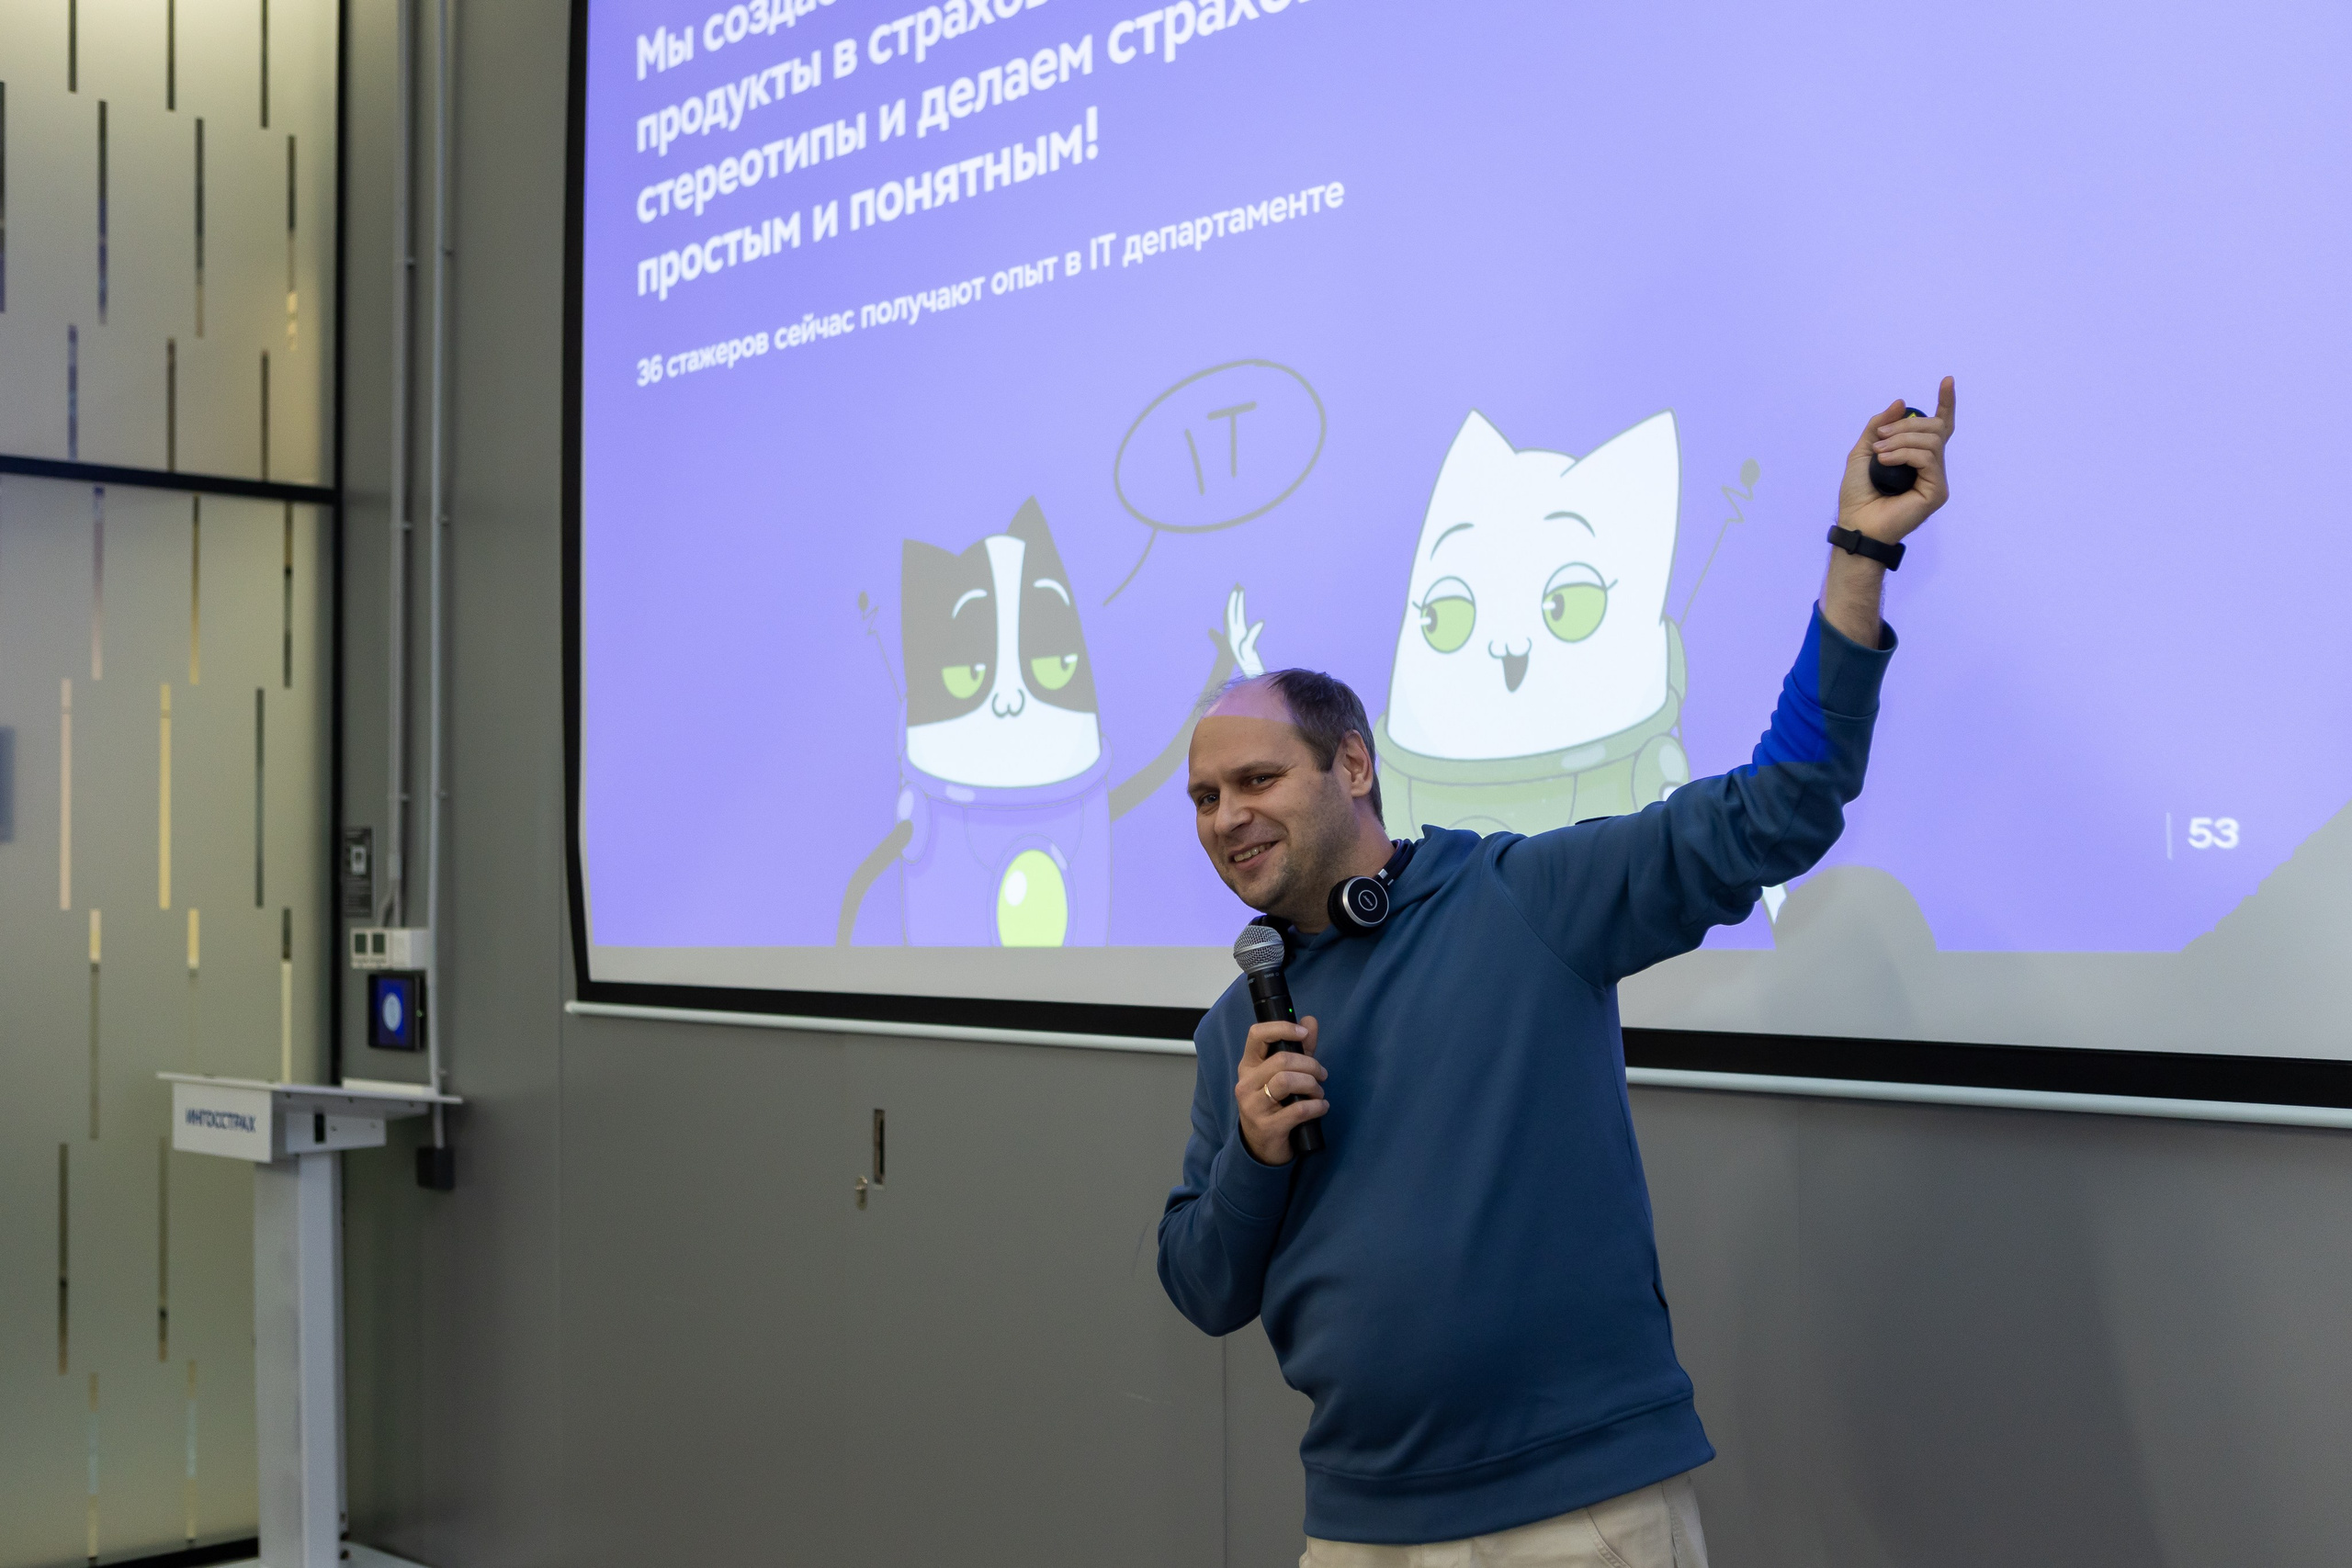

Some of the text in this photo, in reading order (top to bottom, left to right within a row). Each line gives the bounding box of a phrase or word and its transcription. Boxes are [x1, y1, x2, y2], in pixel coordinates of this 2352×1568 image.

[636, 26, 695, 81] Мы
[637, 51, 821, 156] продукты
[833, 39, 858, 79] в
[637, 113, 866, 222] стереотипы
[879, 99, 906, 141] и
[917, 35, 1093, 138] делаем
[638, 106, 1099, 301] простым и понятным!
[638, 182, 1345, 387] 36 стажеров сейчас получают опыт в IT департаменте
[1184, 400, 1257, 496] IT
[2188, 817, 2240, 850] 53
